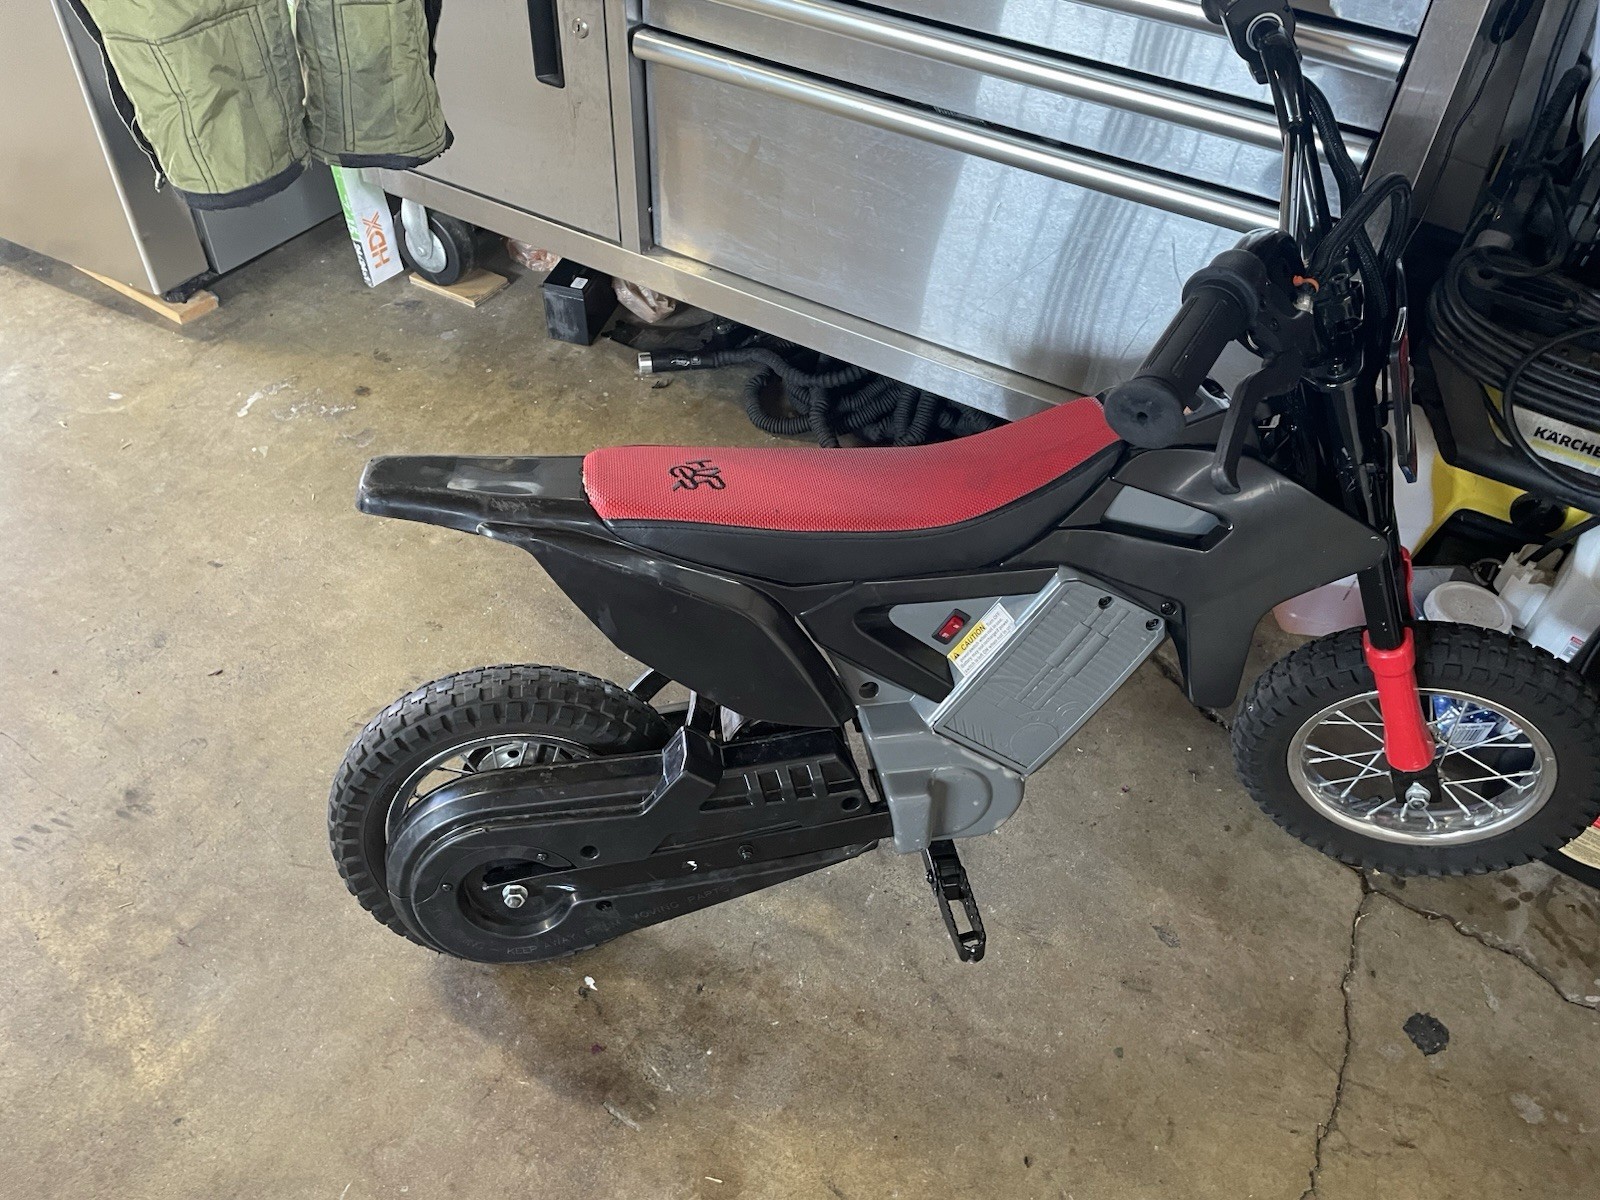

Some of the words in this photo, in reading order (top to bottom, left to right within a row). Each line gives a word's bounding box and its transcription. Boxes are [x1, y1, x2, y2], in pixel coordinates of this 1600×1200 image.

[362, 211, 390, 269] HDX
[961, 624, 986, 651] CAUTION
[506, 945, 537, 955] KEEP
